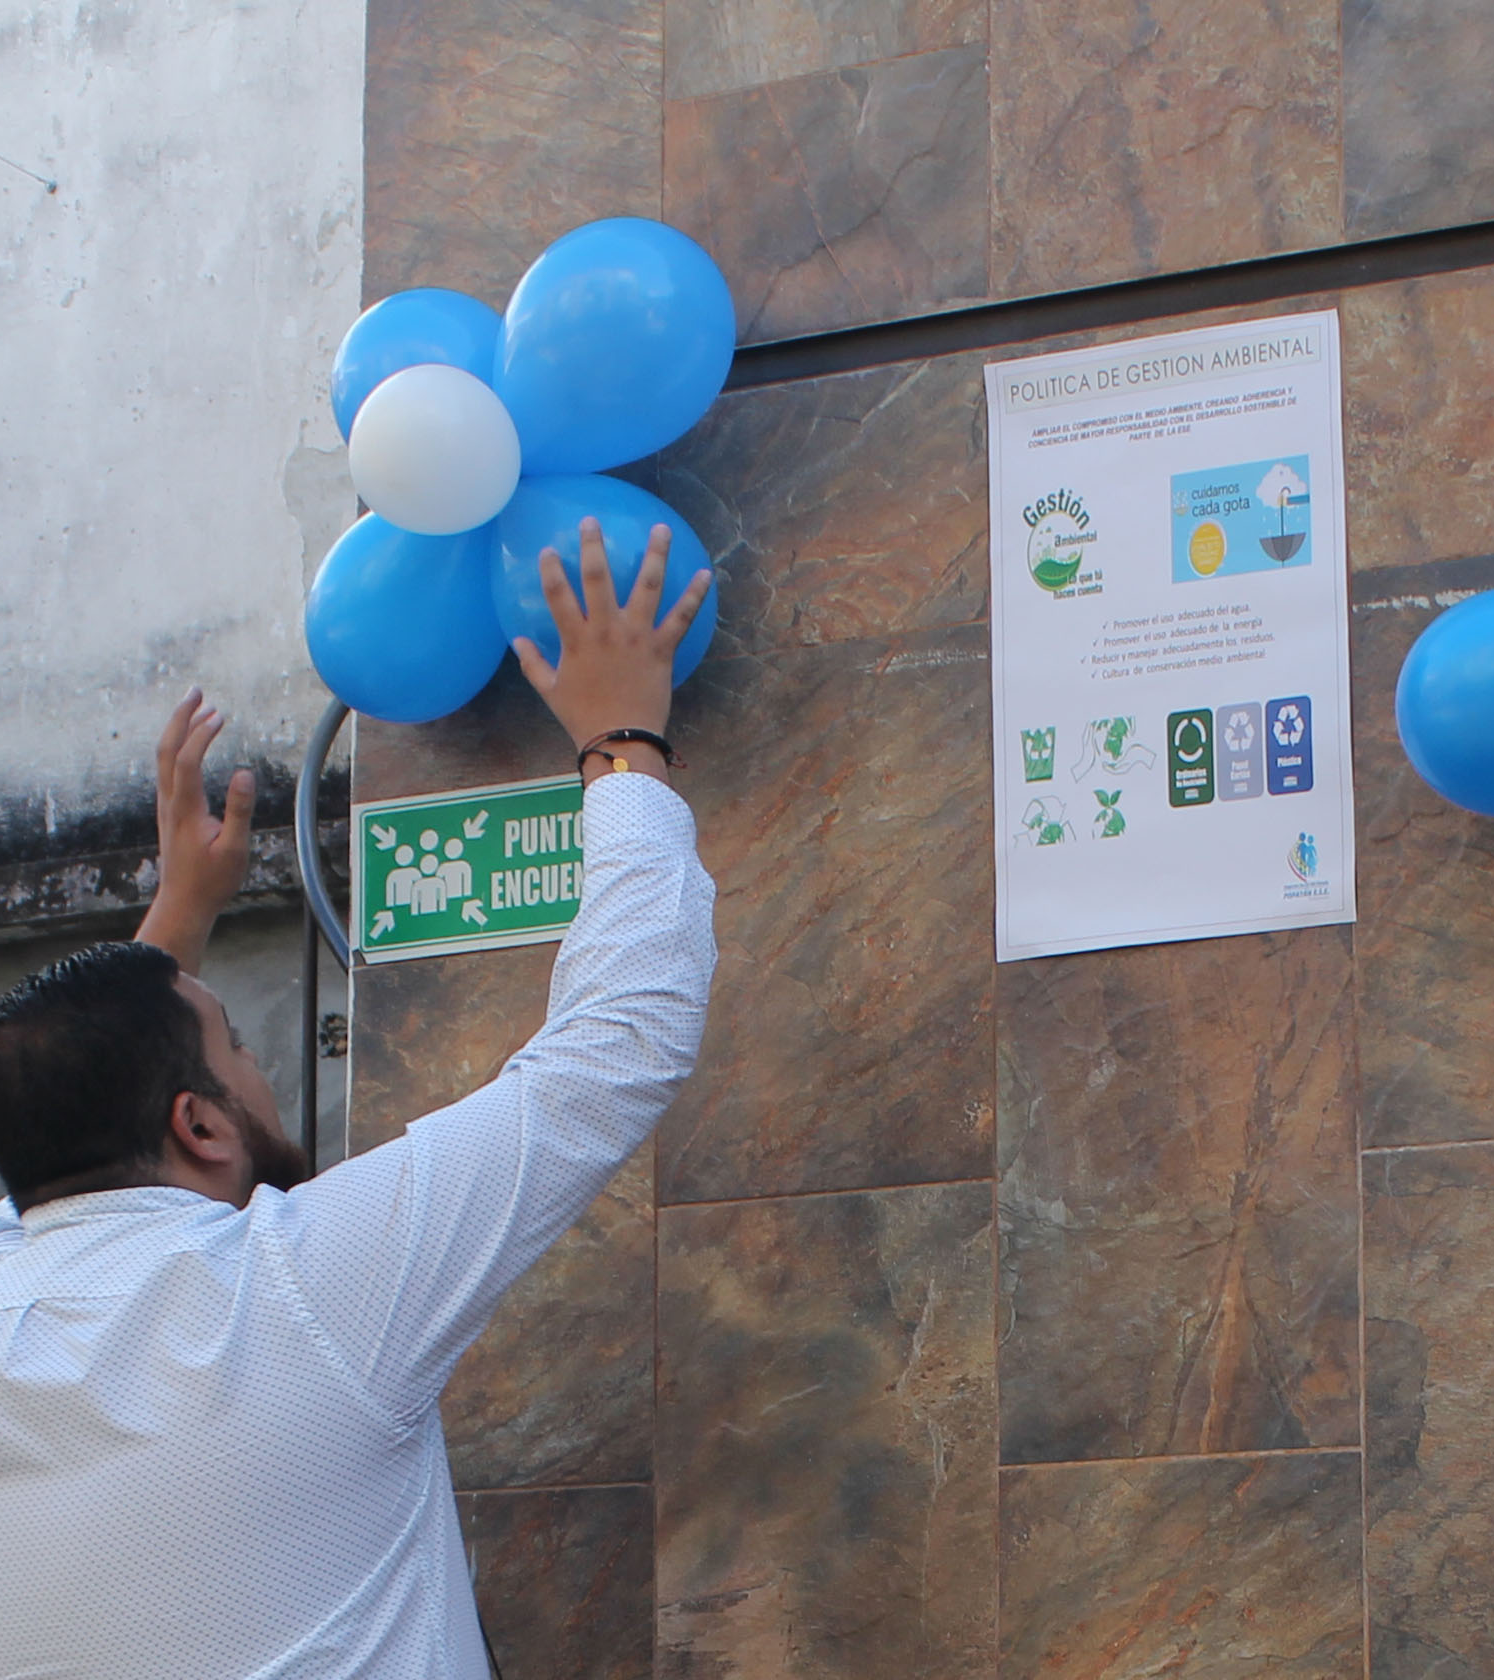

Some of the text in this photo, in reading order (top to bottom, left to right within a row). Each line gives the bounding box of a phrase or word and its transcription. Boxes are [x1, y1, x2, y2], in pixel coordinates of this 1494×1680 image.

[1010, 336, 1314, 404] POLITICA DE GESTION AMBIENTAL
[1191, 483, 1240, 500] cuidamos
[1191, 497, 1251, 517] cada gota
